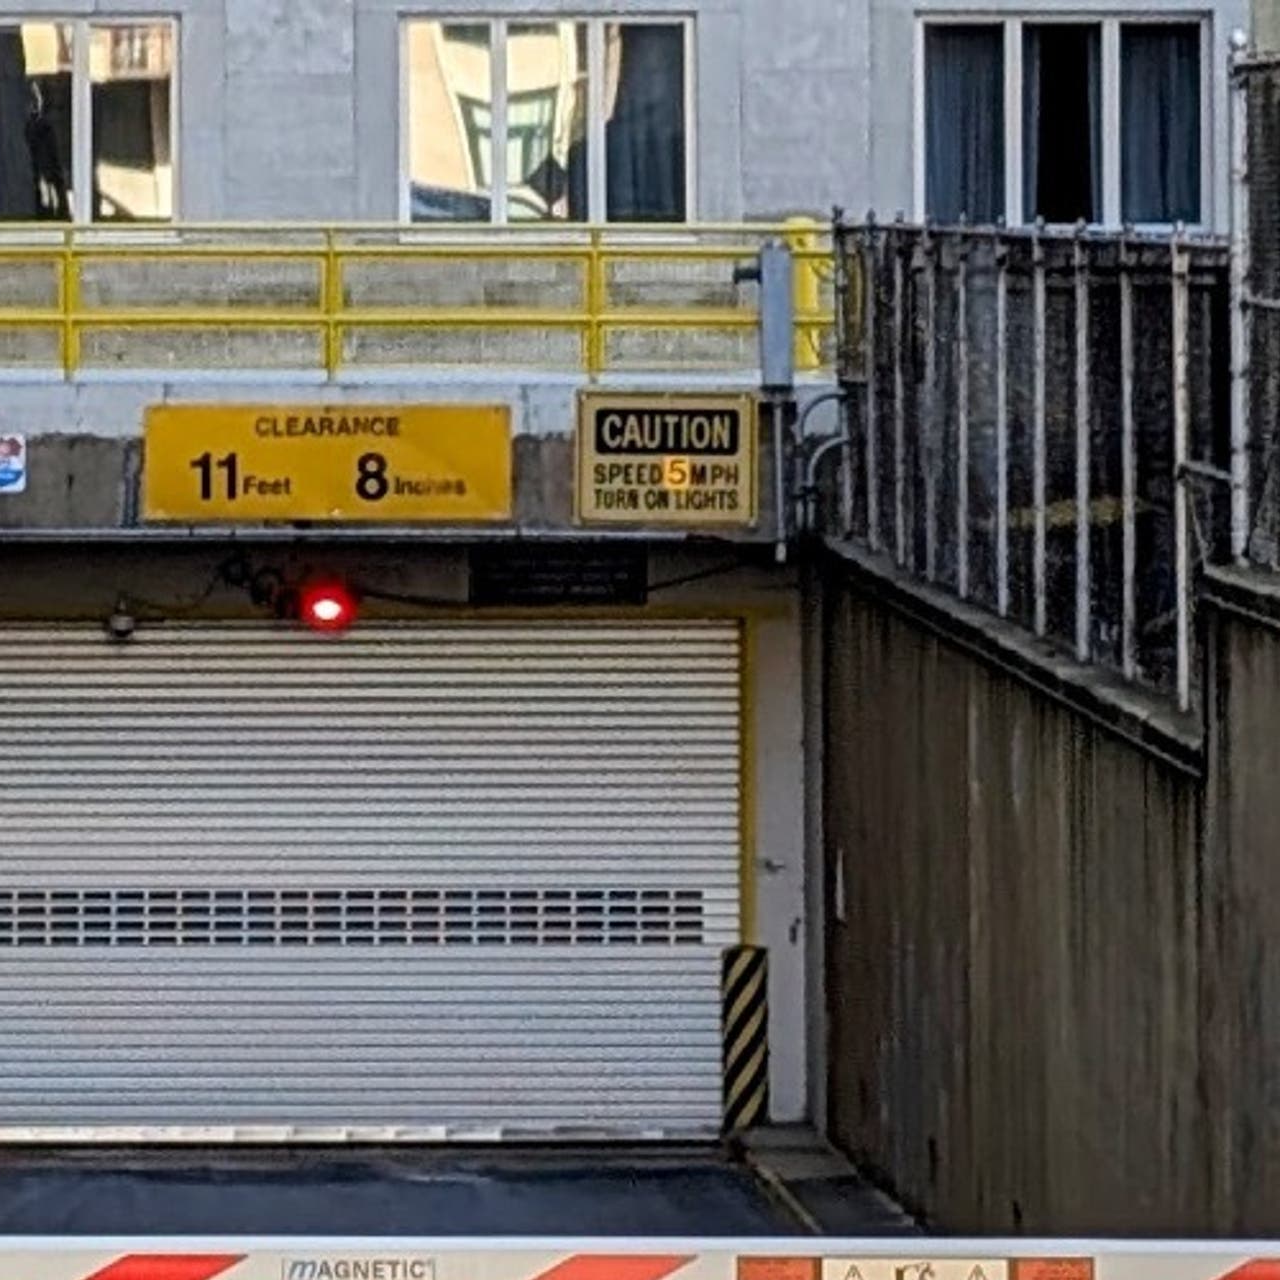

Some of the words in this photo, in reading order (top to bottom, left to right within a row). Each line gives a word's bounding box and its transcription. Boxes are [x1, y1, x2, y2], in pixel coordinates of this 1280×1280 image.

[255, 416, 400, 437] CLEARANCE
[602, 413, 731, 449] CAUTION
[189, 452, 237, 500] 11
[243, 476, 291, 495] Feet
[356, 452, 389, 501] 8
[593, 463, 663, 485] SPEED
[667, 460, 687, 485] 5
[690, 463, 739, 485] MPH
[594, 488, 639, 510] TURN
[644, 488, 670, 510] ON
[673, 488, 739, 511] LIGHTS
